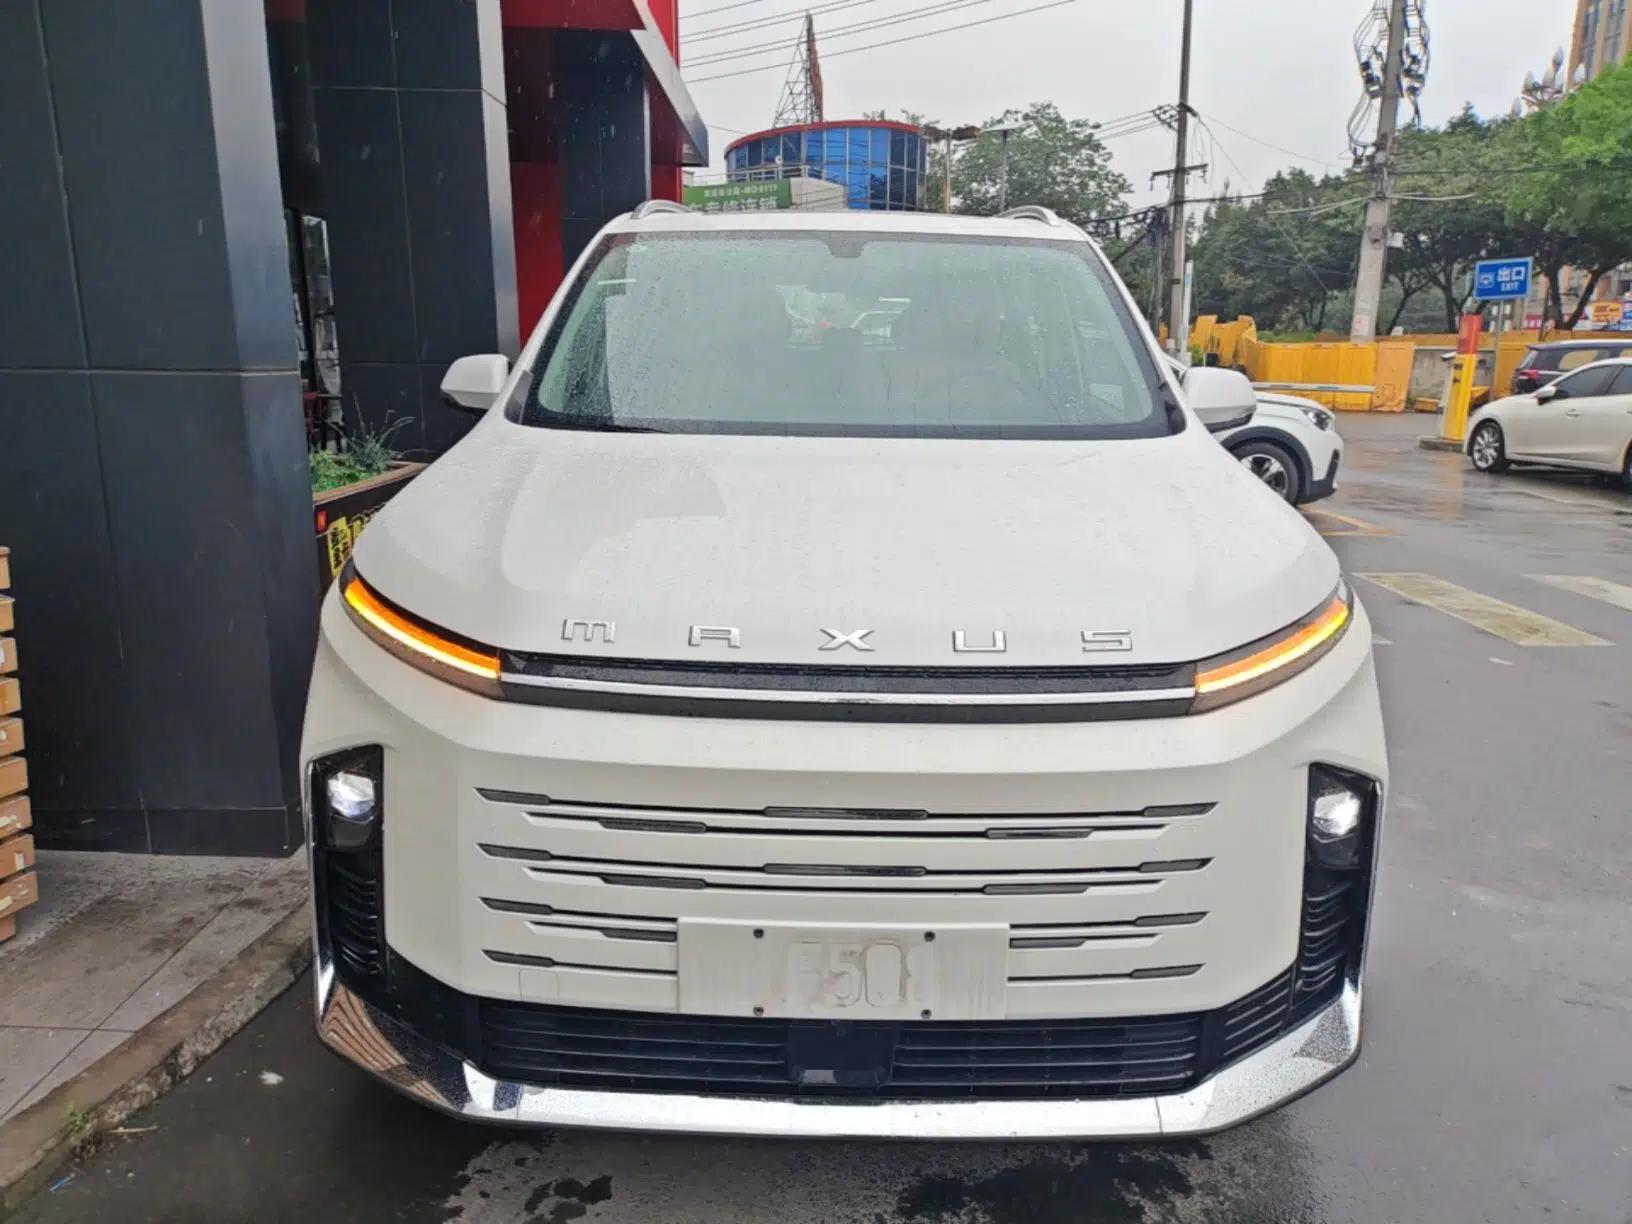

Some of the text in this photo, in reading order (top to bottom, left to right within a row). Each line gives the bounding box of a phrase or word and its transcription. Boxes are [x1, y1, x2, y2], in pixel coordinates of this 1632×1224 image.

[1497, 266, 1525, 282] 出口
[1500, 281, 1520, 291] EXIT
[561, 617, 1134, 652] MAXUS
